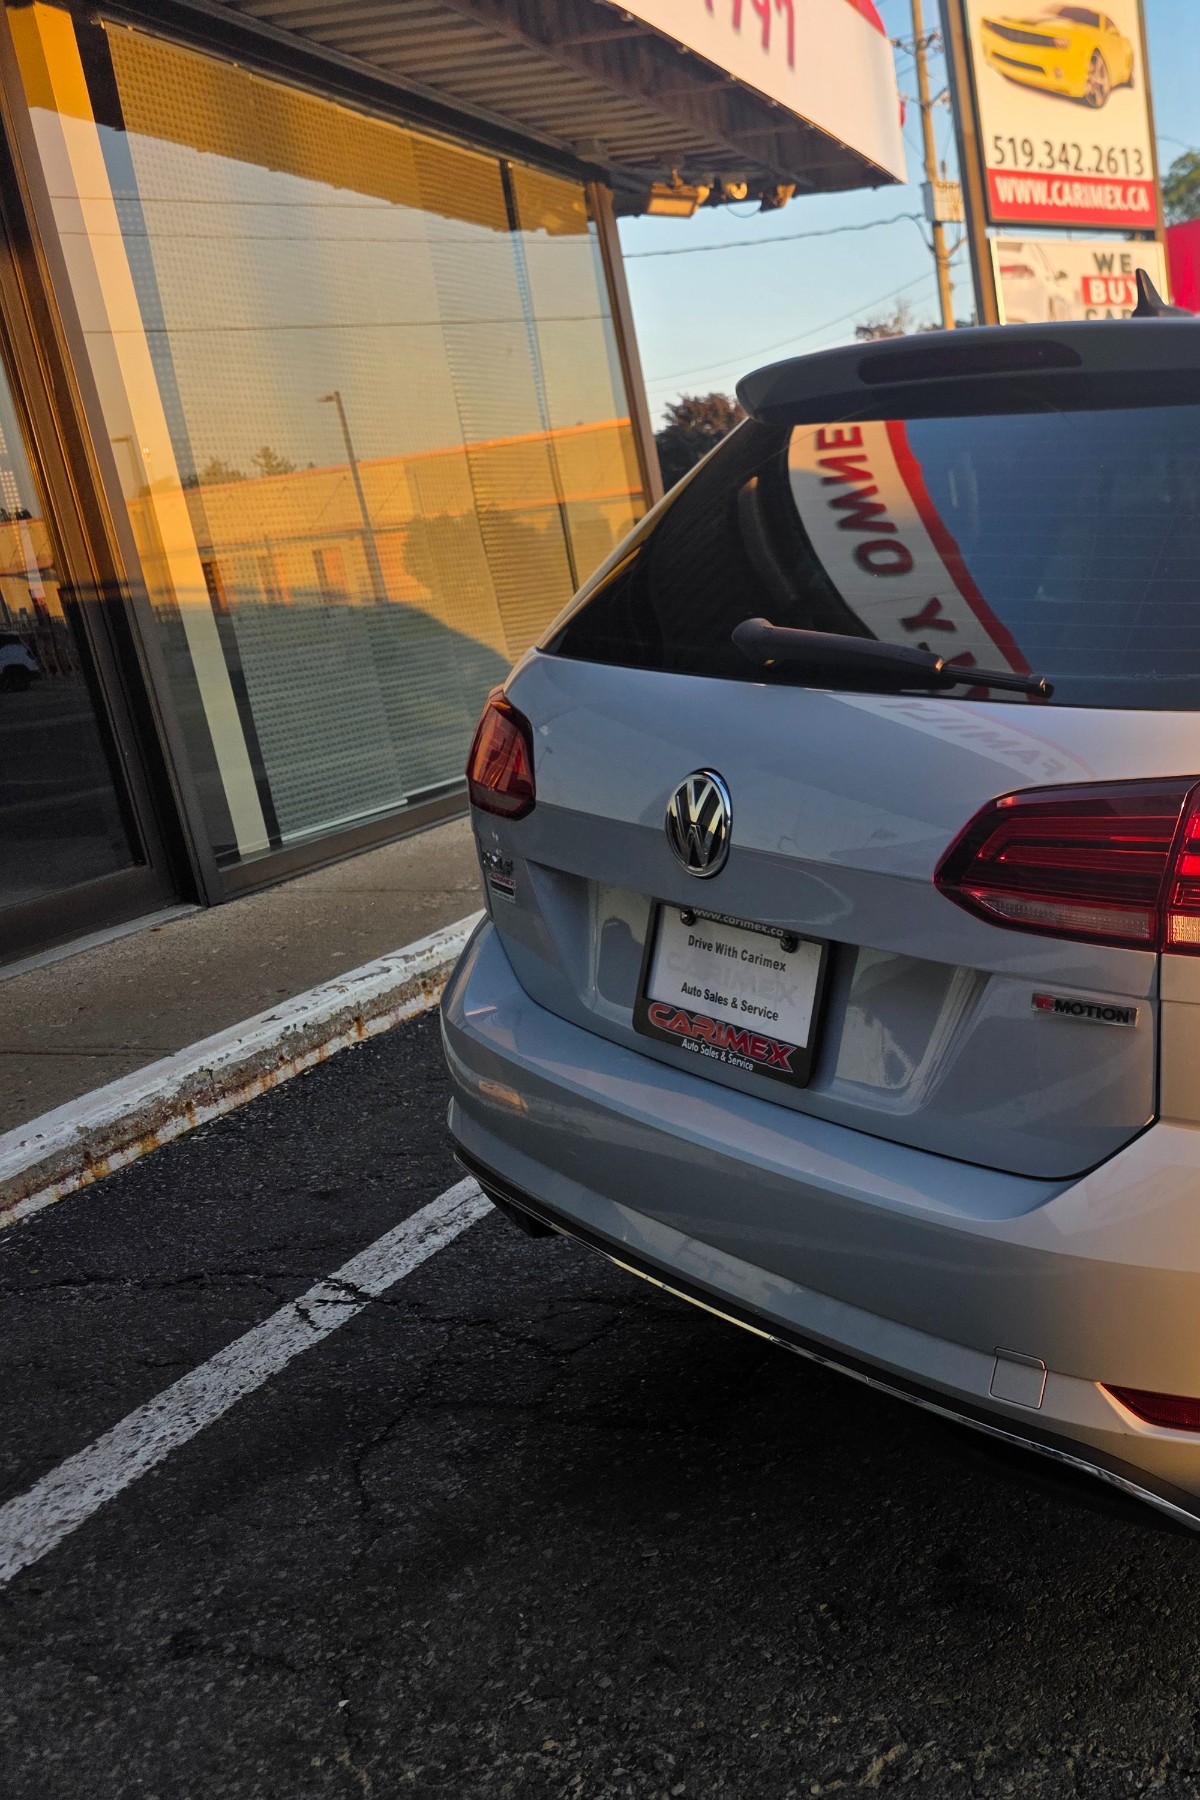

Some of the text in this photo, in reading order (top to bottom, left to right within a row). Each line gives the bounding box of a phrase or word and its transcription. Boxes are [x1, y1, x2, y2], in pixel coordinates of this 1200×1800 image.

[994, 136, 1144, 177] 519.342.2613
[994, 177, 1150, 212] WWW.CARIMEX.CA
[1093, 252, 1132, 273] WE
[692, 907, 784, 937] www.carimex.ca
[688, 934, 787, 973] Drive With Carimex
[680, 982, 779, 1021] Auto Sales & Service
[648, 1003, 797, 1071] CARIMEX
[682, 1039, 754, 1071] Auto Sales & Service
